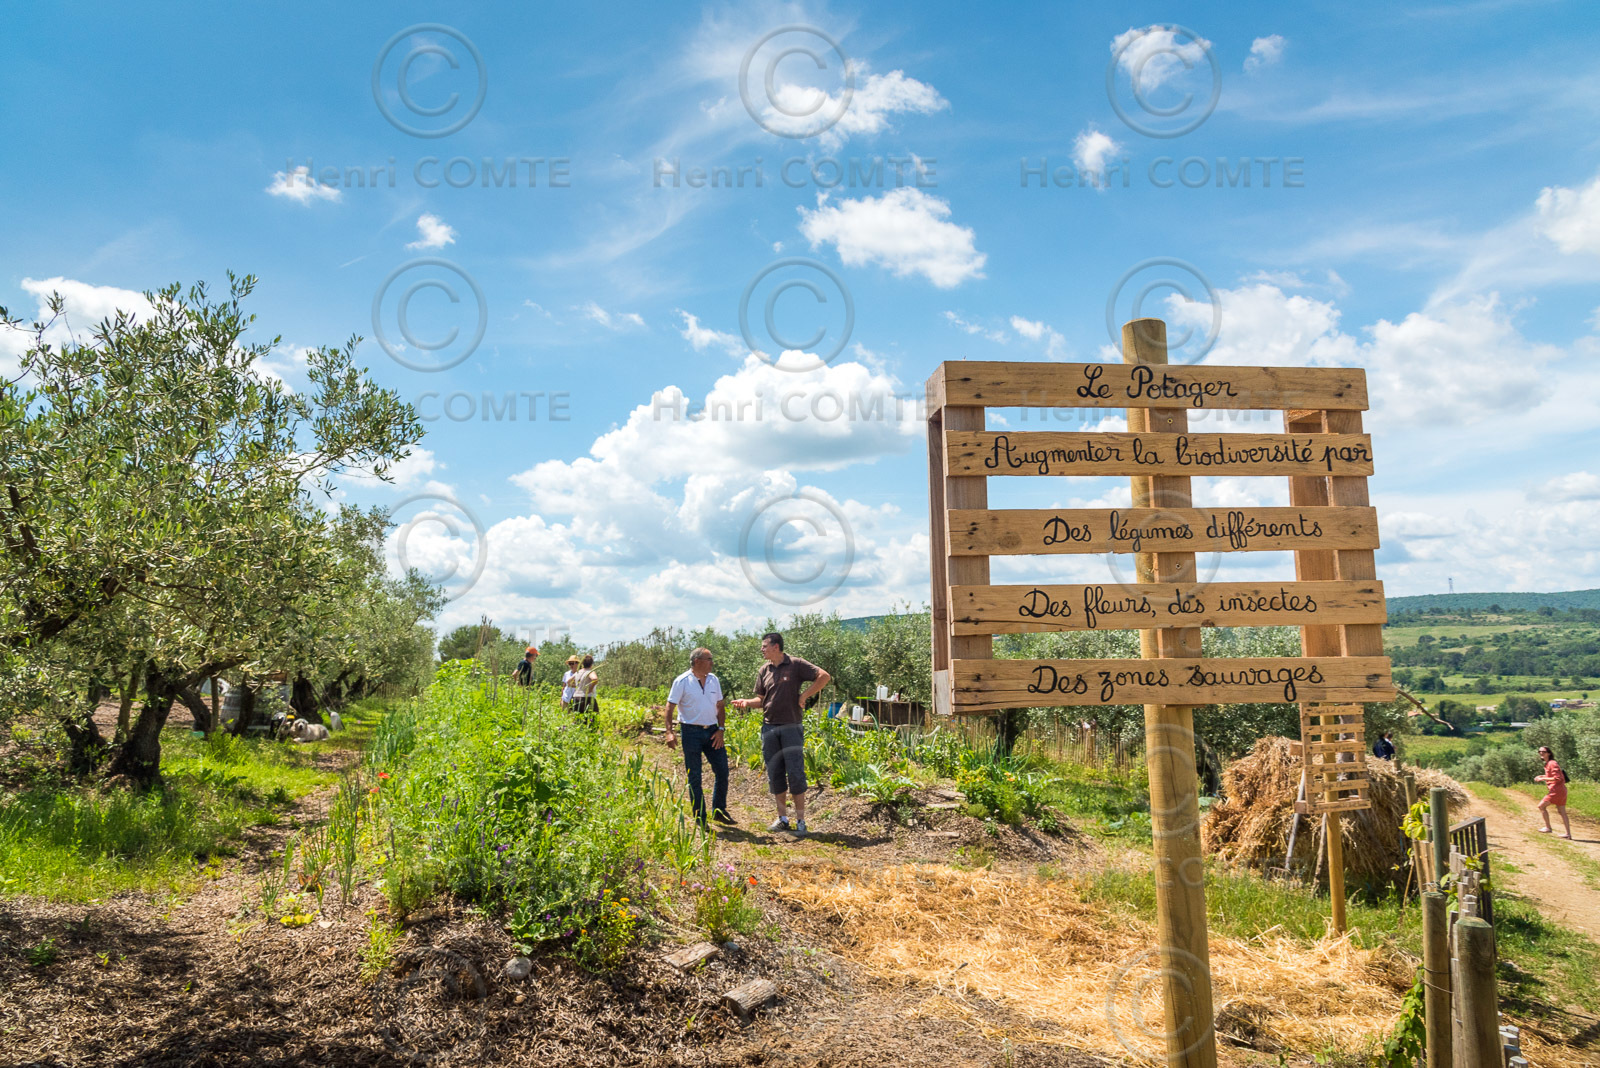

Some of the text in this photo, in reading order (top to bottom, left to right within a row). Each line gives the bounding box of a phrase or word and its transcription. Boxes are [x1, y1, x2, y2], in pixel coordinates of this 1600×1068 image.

[1076, 364, 1238, 408] Le Potager
[984, 435, 1373, 475] Augmenter la biodiversité par
[1043, 510, 1323, 553] Des légumes différents
[1018, 586, 1317, 629] Des fleurs, des insectes
[1027, 665, 1089, 695] Des
[1097, 669, 1170, 703] zones
